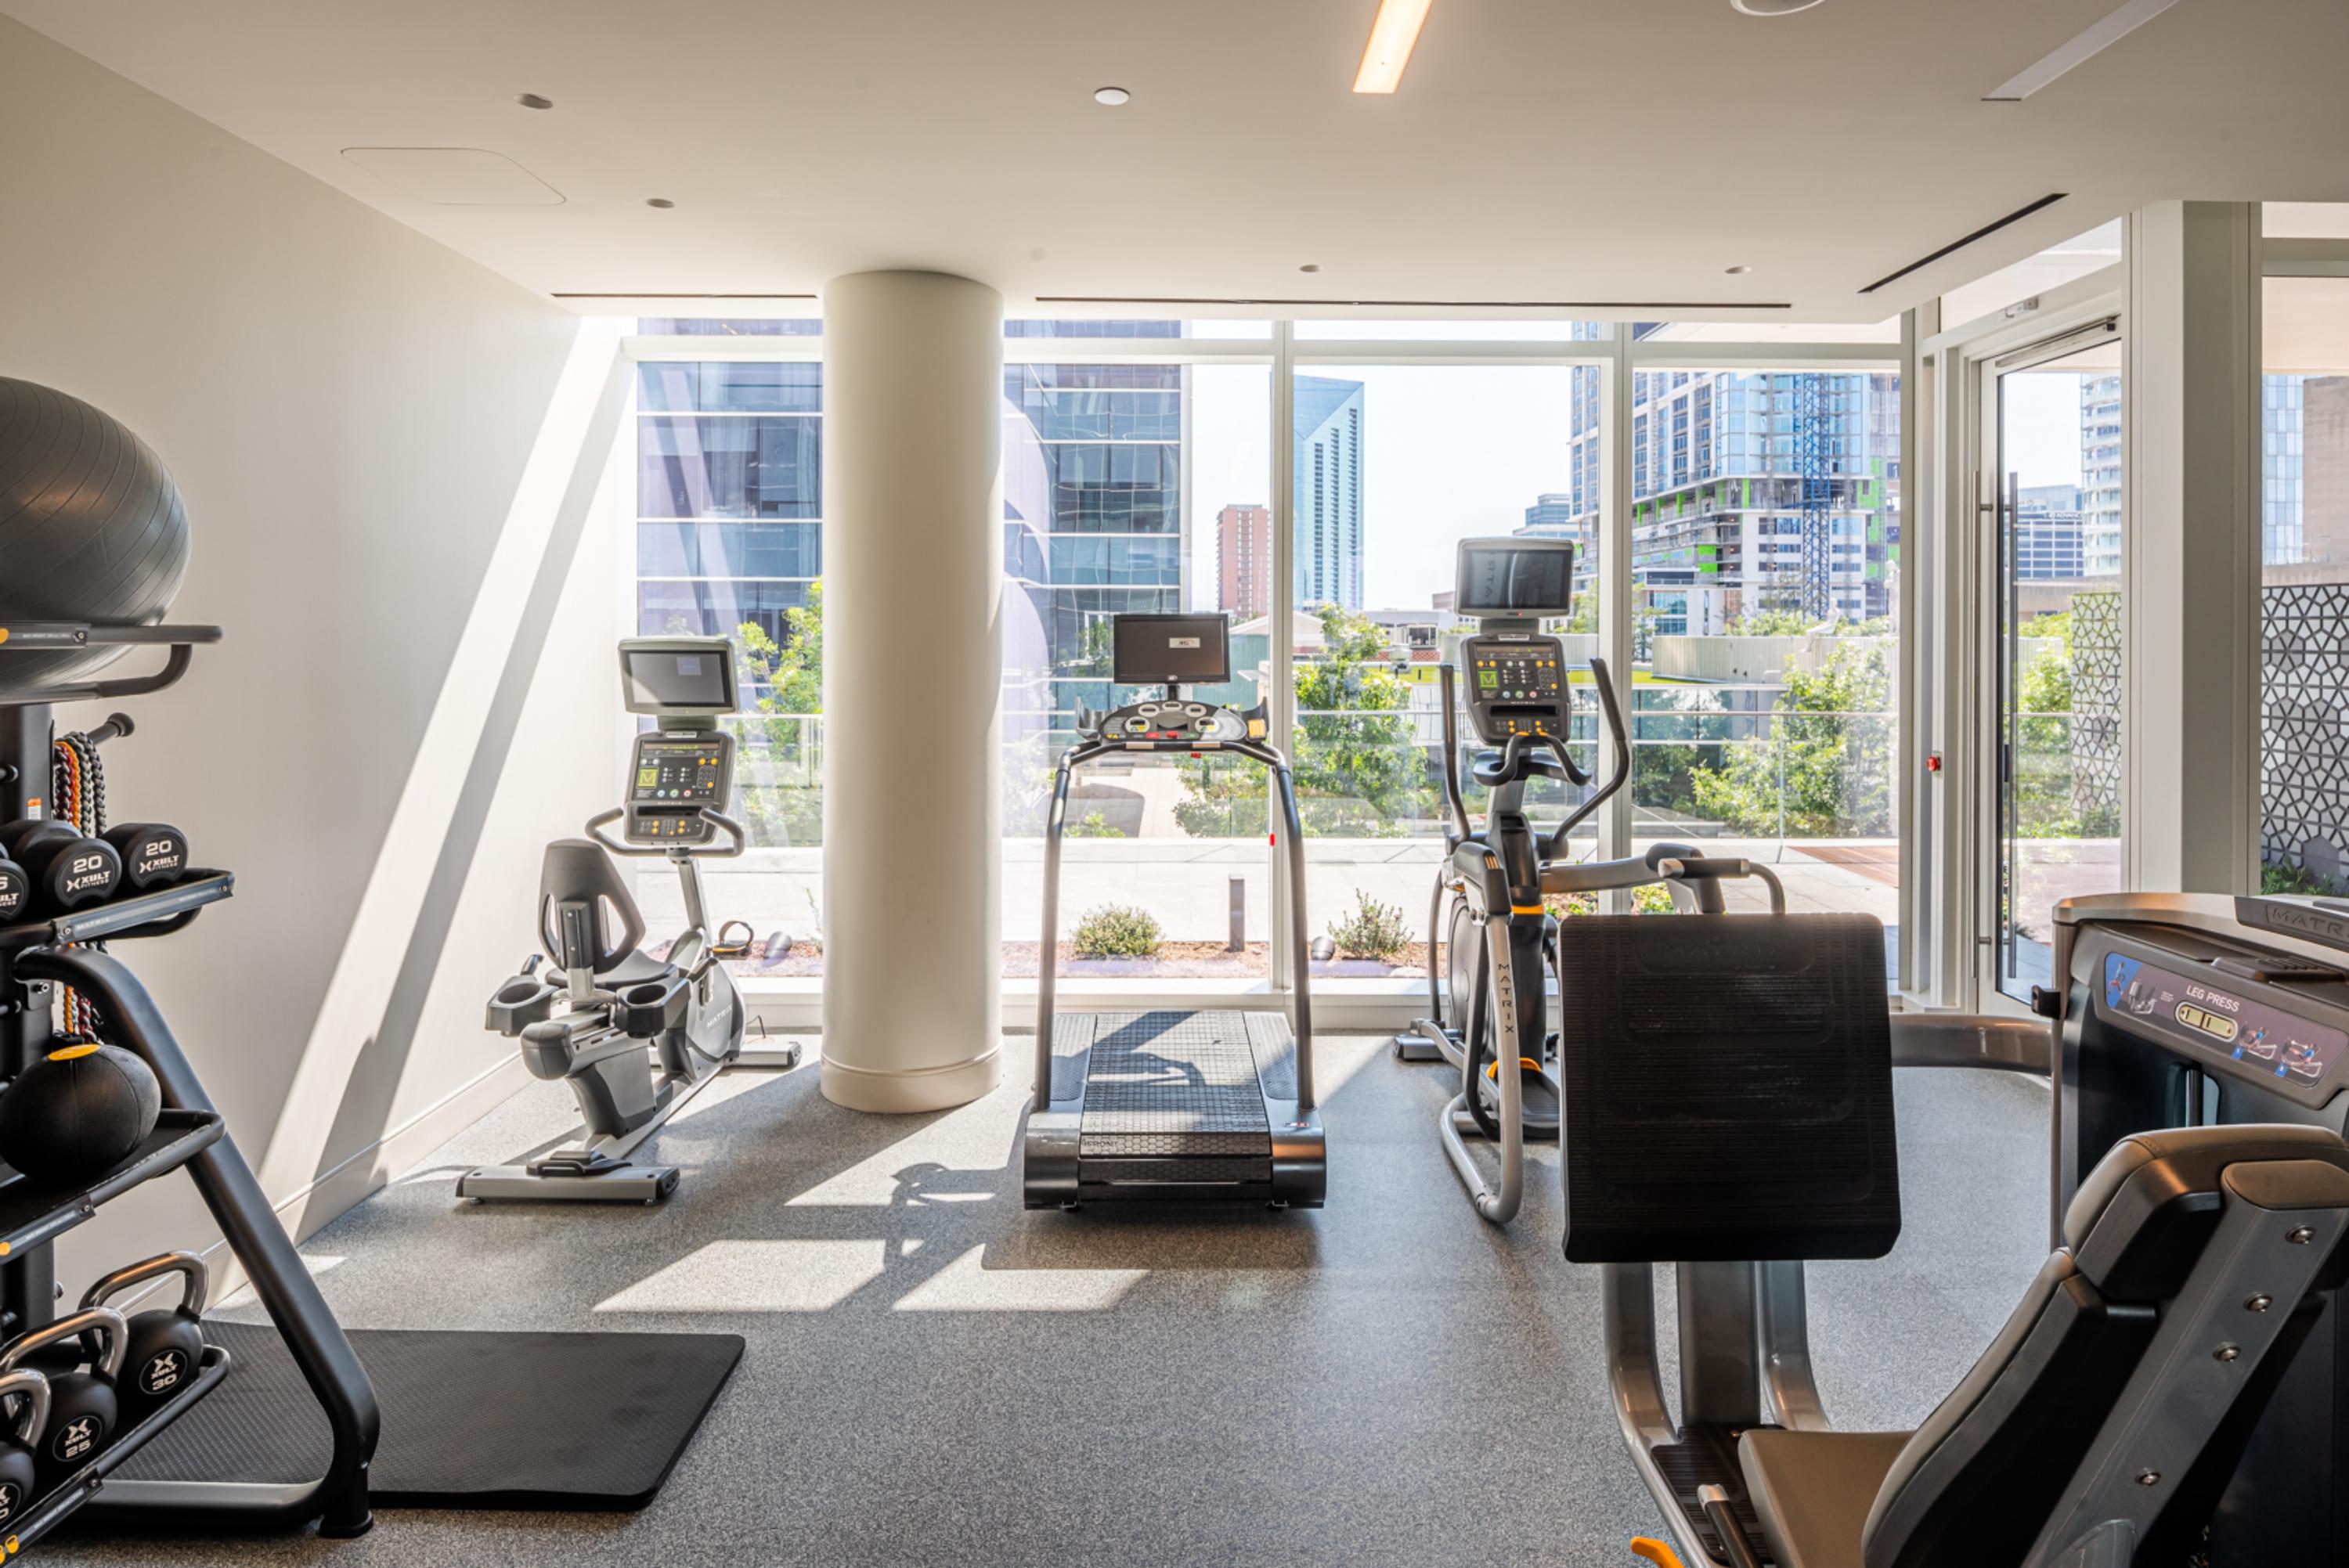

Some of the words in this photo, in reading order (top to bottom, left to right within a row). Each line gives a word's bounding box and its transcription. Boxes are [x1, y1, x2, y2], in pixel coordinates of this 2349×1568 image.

[146, 839, 172, 856] 20
[73, 854, 103, 874] 20
[153, 854, 179, 867] XULT
[81, 871, 111, 884] XULT
[81, 878, 110, 889] FITNESS
[0, 892, 20, 903] ULT
[2271, 907, 2349, 938] MATR
[1498, 963, 1514, 1033] MATRIX
[2185, 985, 2205, 1000] LEG
[2206, 992, 2240, 1012] PRESS
[153, 1374, 177, 1390] 30
[66, 1439, 91, 1458] 25
